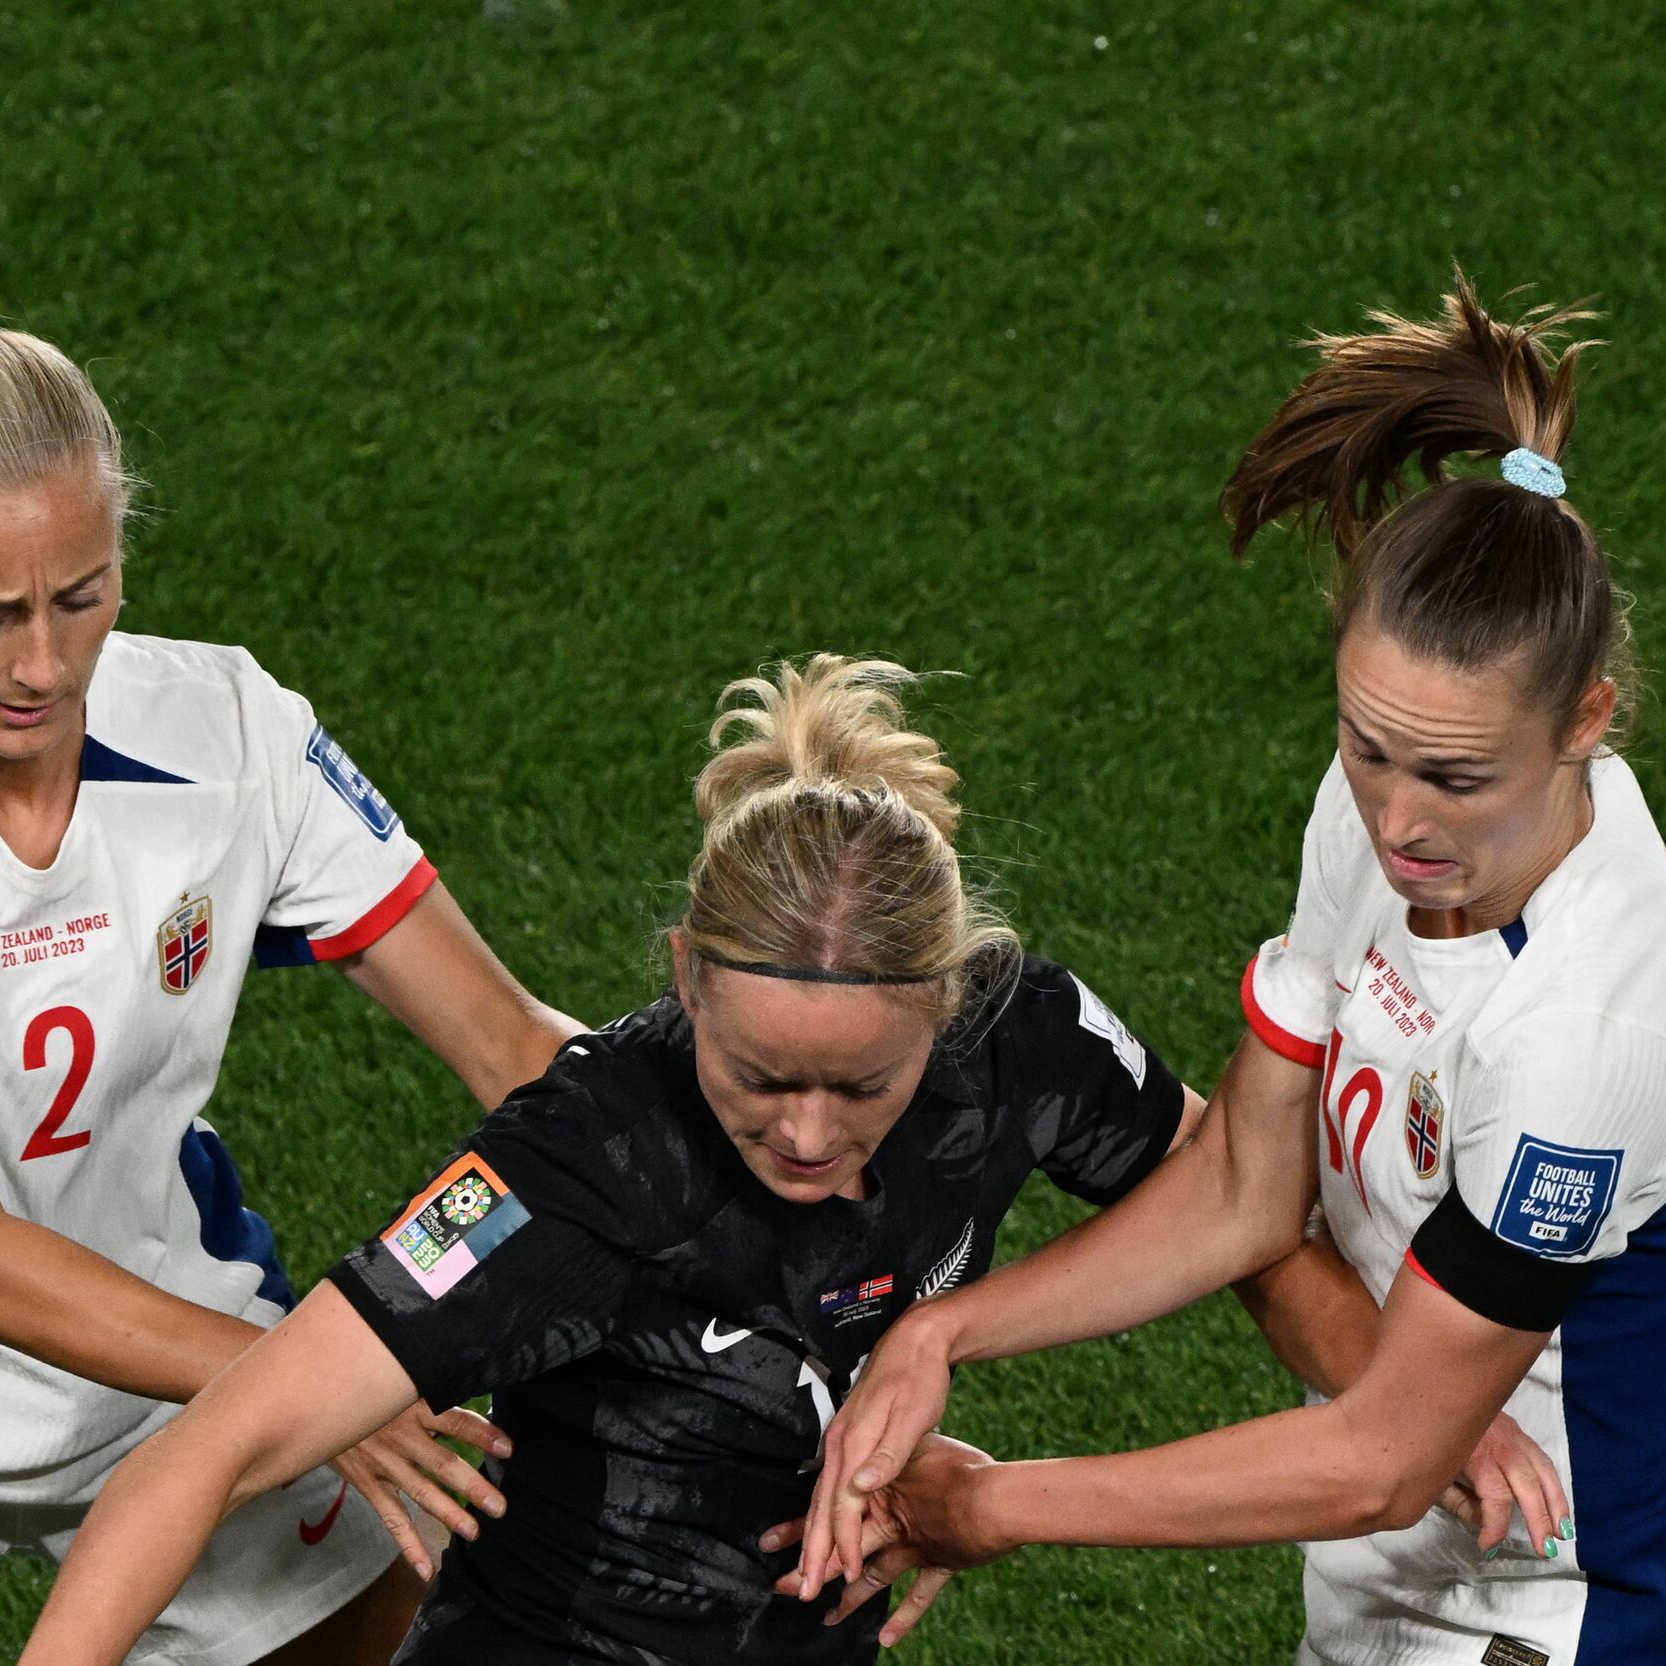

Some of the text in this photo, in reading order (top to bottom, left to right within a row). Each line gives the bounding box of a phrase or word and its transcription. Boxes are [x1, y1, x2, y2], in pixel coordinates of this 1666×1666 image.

[1, 926, 54, 949] ZEALAND
[66, 913, 111, 935] NORGE
[1, 938, 85, 968] 20. JULI 2023
[1365, 945, 1387, 972] NEW
[1382, 966, 1418, 1009] ZEALAND
[1415, 1009, 1436, 1036] NOR
[1368, 978, 1418, 1038] 20. JULI 2023
[19, 1005, 96, 1162] 2
[1535, 1161, 1596, 1187] FOOTBALL
[1529, 1177, 1594, 1208] UNITES
[427, 1205, 440, 1219] FIFA
[1520, 1199, 1592, 1226] the World
[406, 1223, 440, 1260] AU 20
[418, 1216, 445, 1243] WORLD CUP
[1535, 1226, 1560, 1238] FIFA
[398, 1232, 432, 1269] NZ 23
